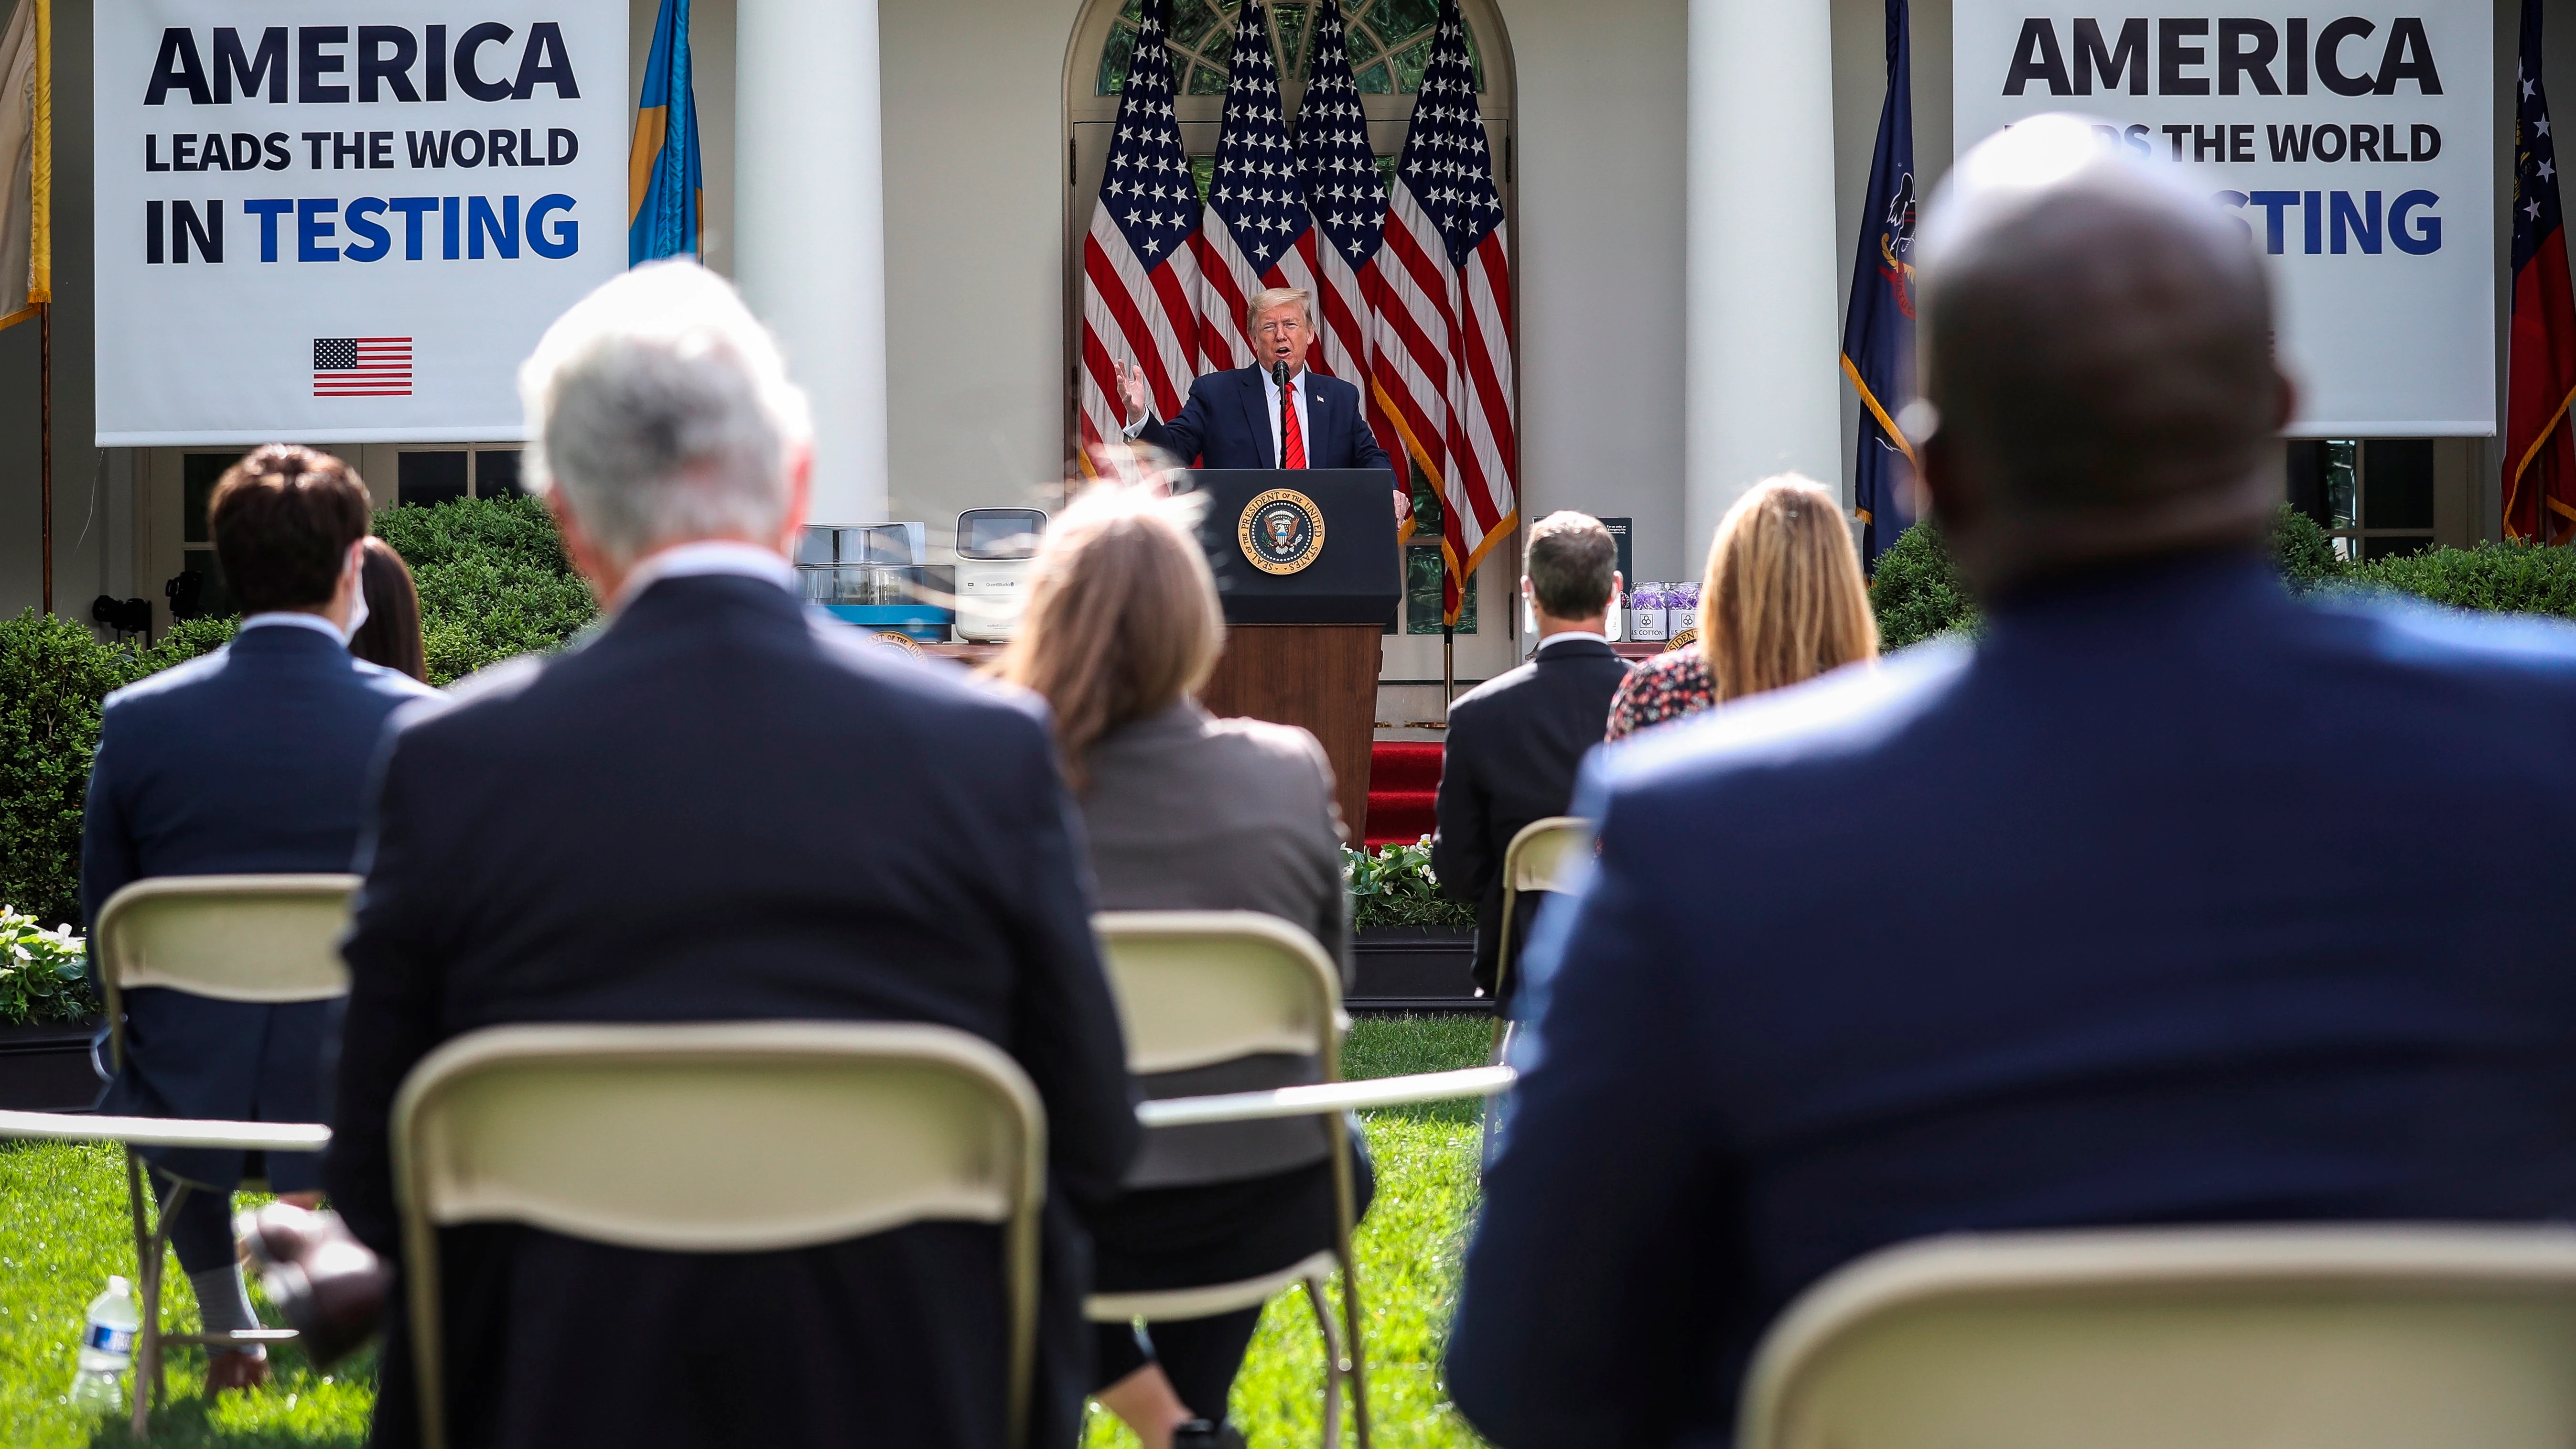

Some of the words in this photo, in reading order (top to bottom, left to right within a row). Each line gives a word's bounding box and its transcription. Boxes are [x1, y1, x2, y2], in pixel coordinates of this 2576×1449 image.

[143, 22, 581, 105] AMERICA
[2002, 17, 2443, 96] AMERICA
[146, 131, 291, 171] LEADS
[302, 131, 394, 170] THE
[406, 128, 578, 169] WORLD
[2162, 124, 2255, 162] THE
[2266, 124, 2441, 162] WORLD
[147, 199, 224, 264] IN
[244, 194, 578, 263] TESTING
[2209, 189, 2441, 255] STING
[1240, 492, 1280, 530] PRESIDENT
[1292, 495, 1303, 504] THE
[1304, 502, 1322, 537] UNITED
[1245, 545, 1252, 553] OF
[1251, 552, 1274, 571] SEAL
[1289, 545, 1318, 571] STATES
[896, 637, 908, 645] THE
[1669, 630, 1699, 652] SIDENT
